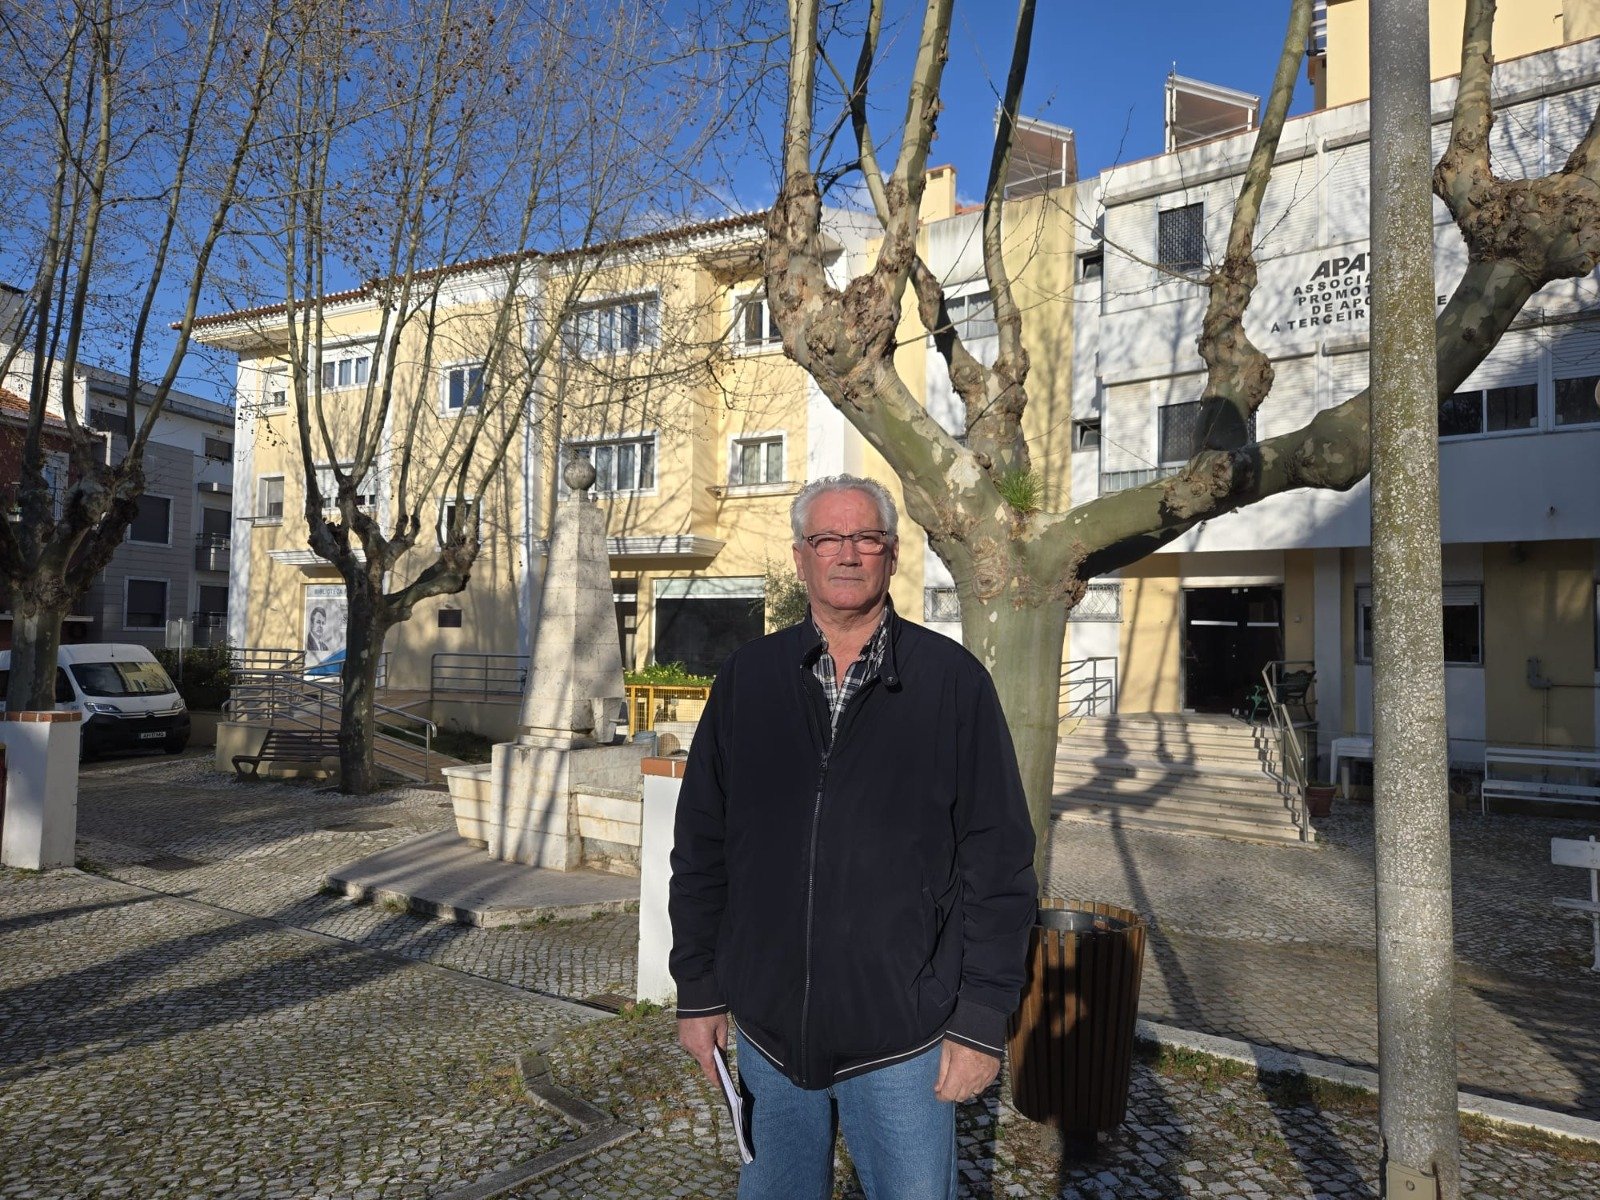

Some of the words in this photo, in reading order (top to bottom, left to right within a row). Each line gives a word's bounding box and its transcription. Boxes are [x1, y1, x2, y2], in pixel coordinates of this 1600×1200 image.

[1310, 252, 1370, 281] APA
[1293, 273, 1370, 296] ASSOCIA
[1298, 285, 1370, 306] PROMOT
[1312, 303, 1333, 315] DE
[1340, 296, 1370, 310] APO
[1287, 309, 1365, 329] TERCEIR
